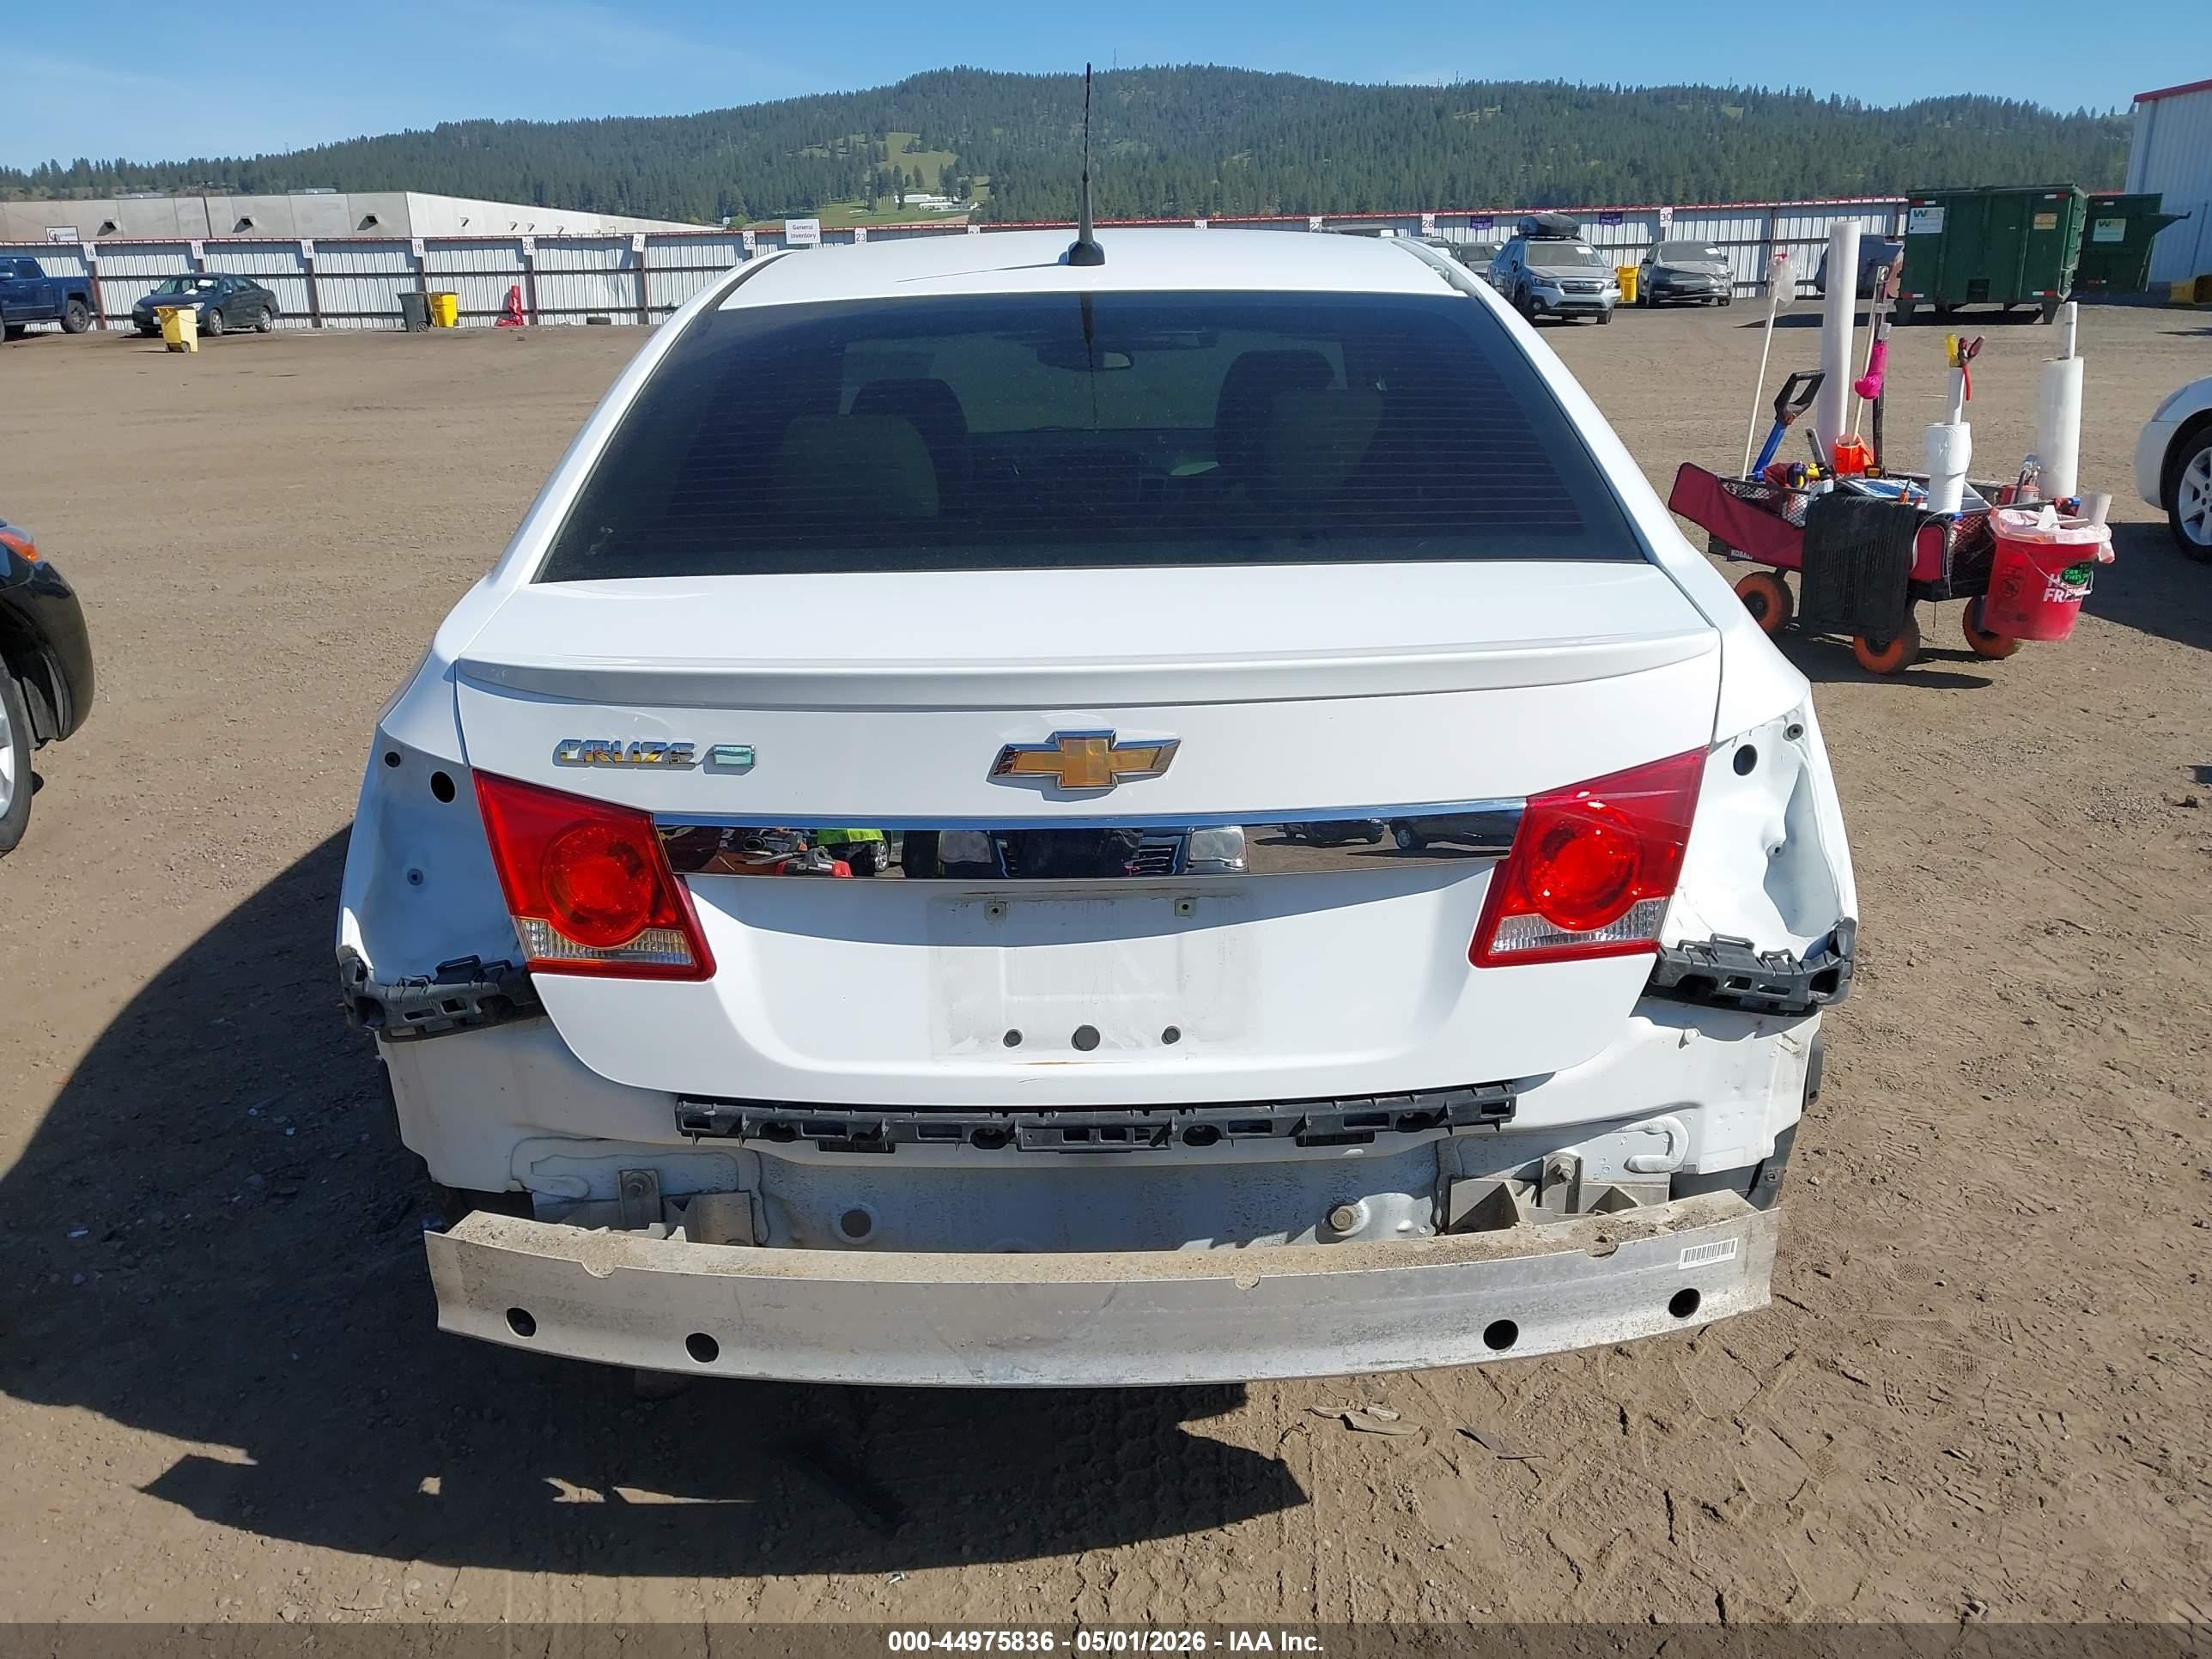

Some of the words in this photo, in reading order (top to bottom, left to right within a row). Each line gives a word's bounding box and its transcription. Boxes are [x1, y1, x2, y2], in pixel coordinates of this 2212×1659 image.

[1661, 213, 1672, 222] 30
[1422, 219, 1434, 228] 28
[744, 235, 755, 245] 22
[855, 233, 866, 242] 23
[523, 241, 533, 250] 20
[634, 238, 644, 247] 21
[193, 246, 202, 254] 17
[303, 245, 313, 253] 18
[414, 243, 422, 252] 19
[560, 739, 696, 763] CRUZE
